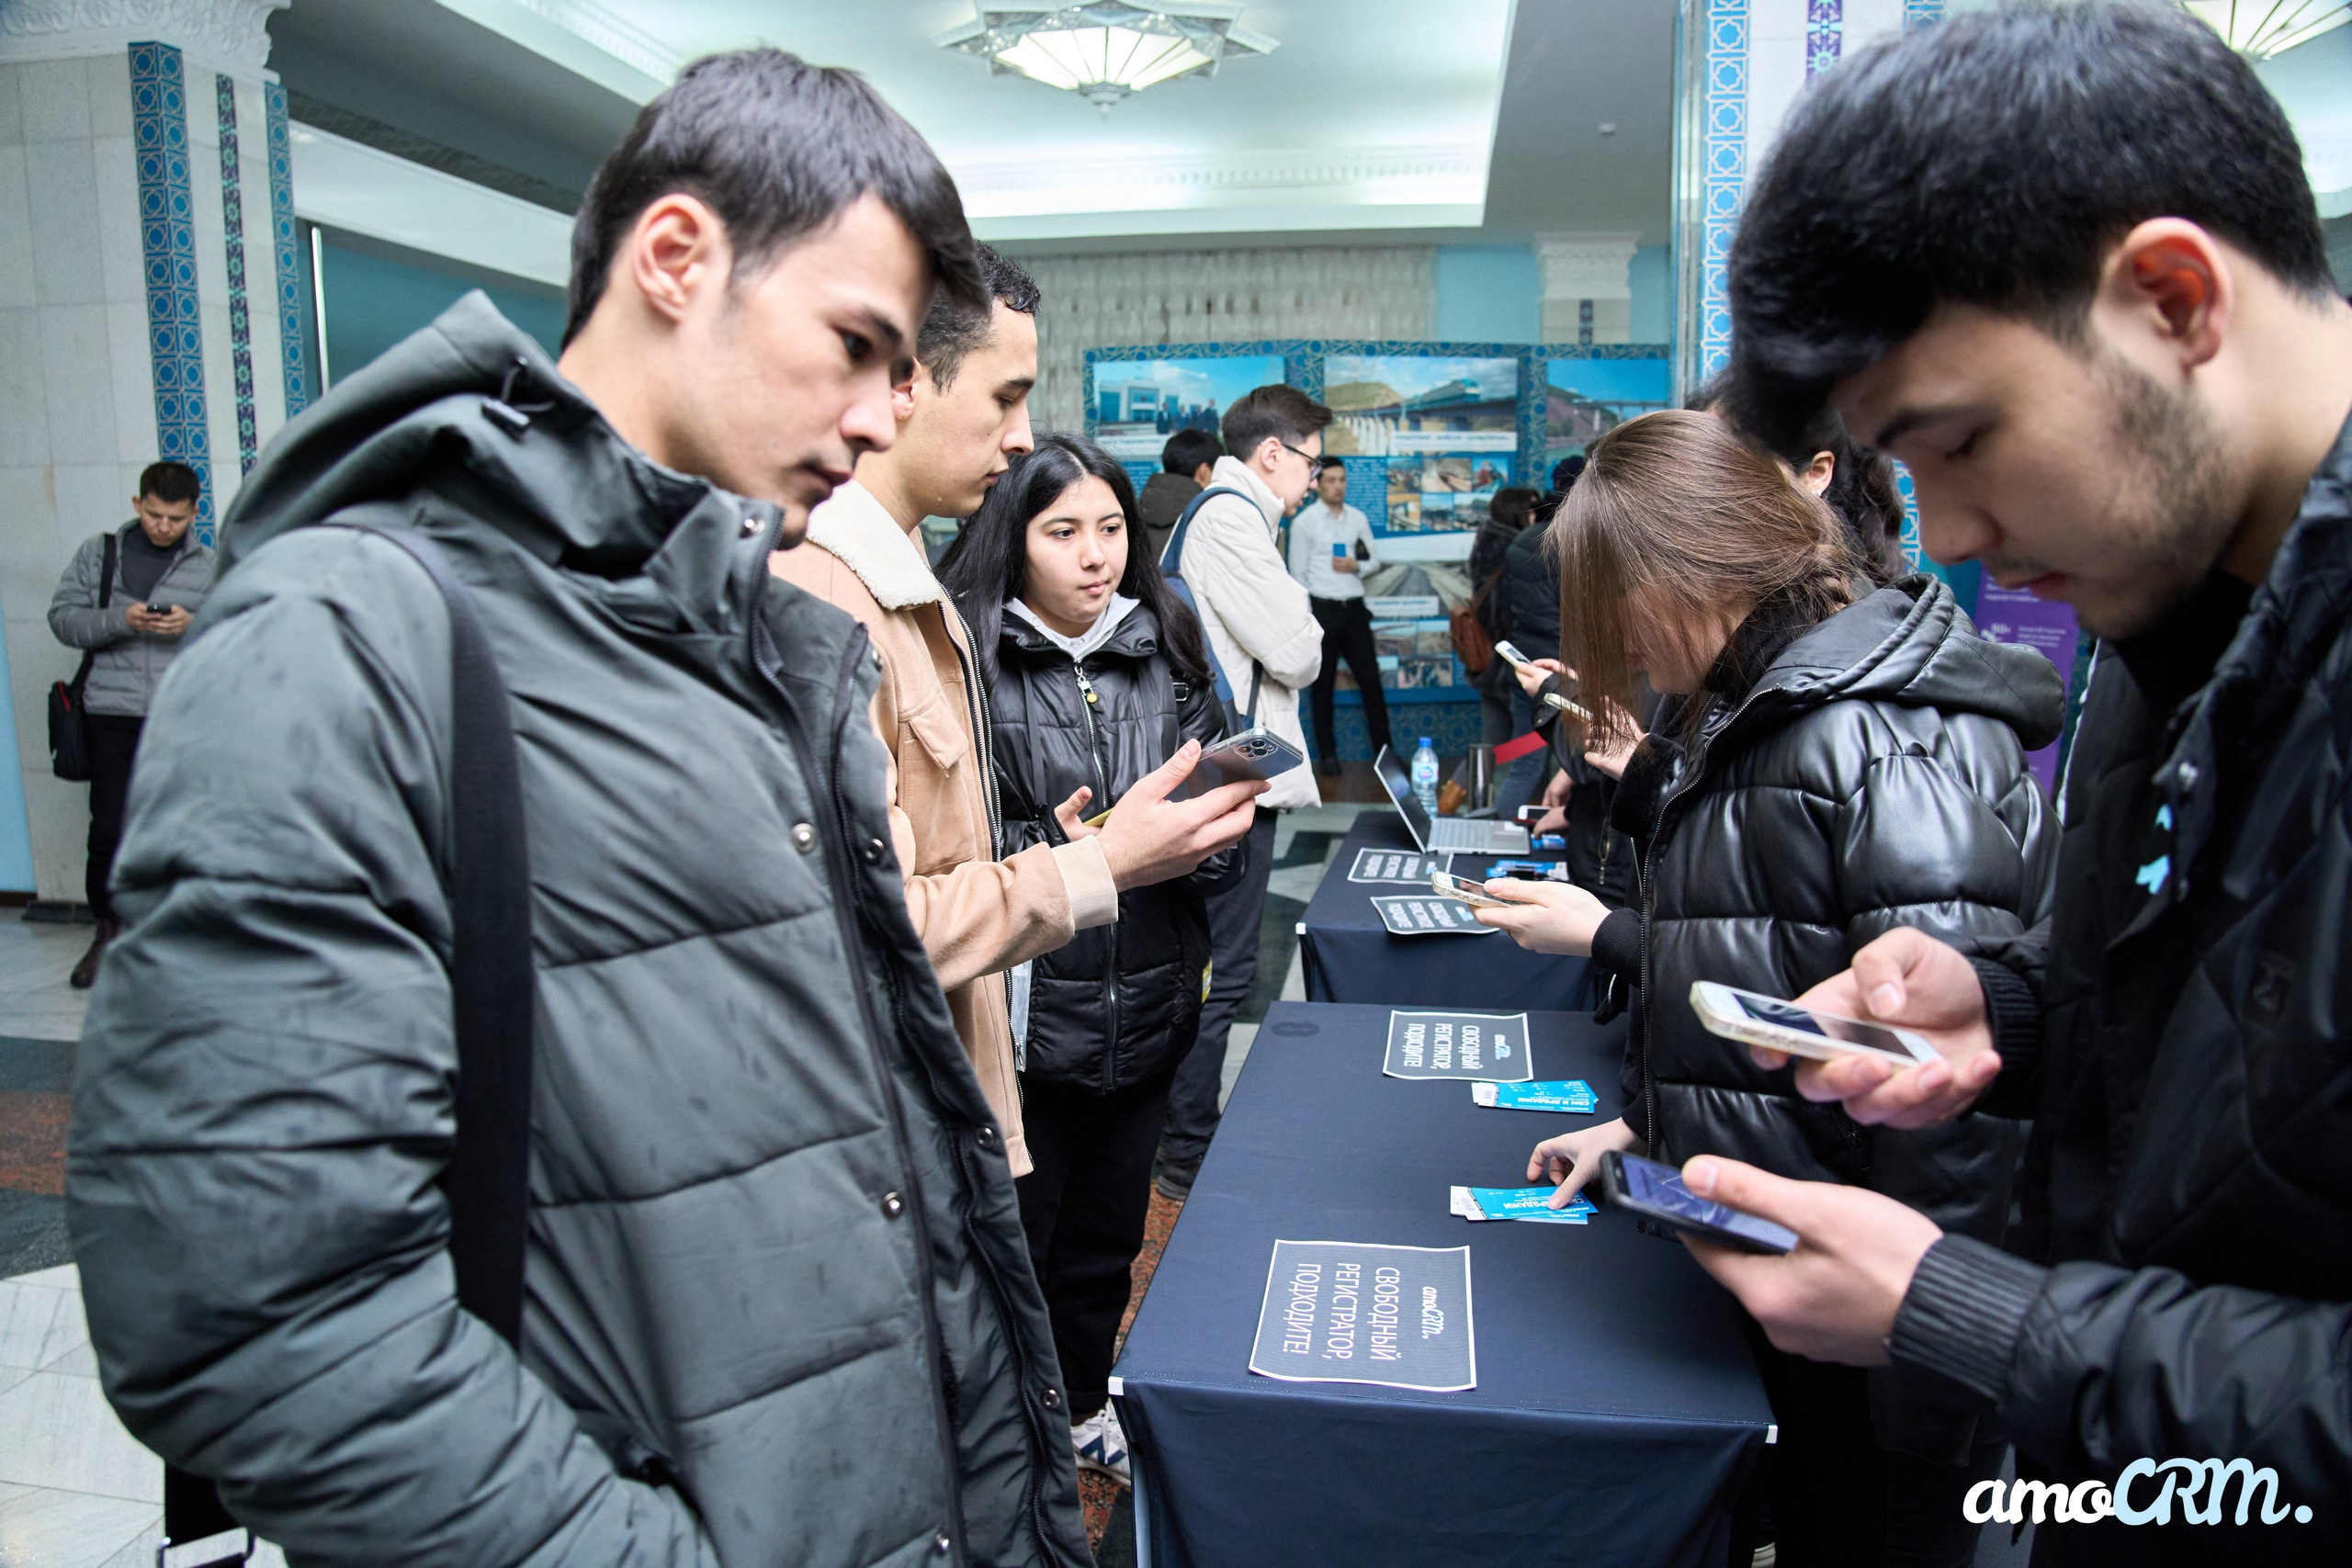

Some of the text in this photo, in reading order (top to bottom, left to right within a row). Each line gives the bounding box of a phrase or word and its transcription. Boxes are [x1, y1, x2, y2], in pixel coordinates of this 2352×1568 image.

[1401, 1022, 1426, 1067] ПОДХОДИТЕ!
[1430, 1022, 1453, 1070] РЕГИСТРАТОР,
[1458, 1024, 1484, 1069] СВОБОДНЫЙ
[1283, 1263, 1322, 1355] ПОДХОДИТЕ!
[1321, 1262, 1362, 1359] РЕГИСТРАТОР,
[1367, 1267, 1402, 1360] СВОБОДНЫЙ
